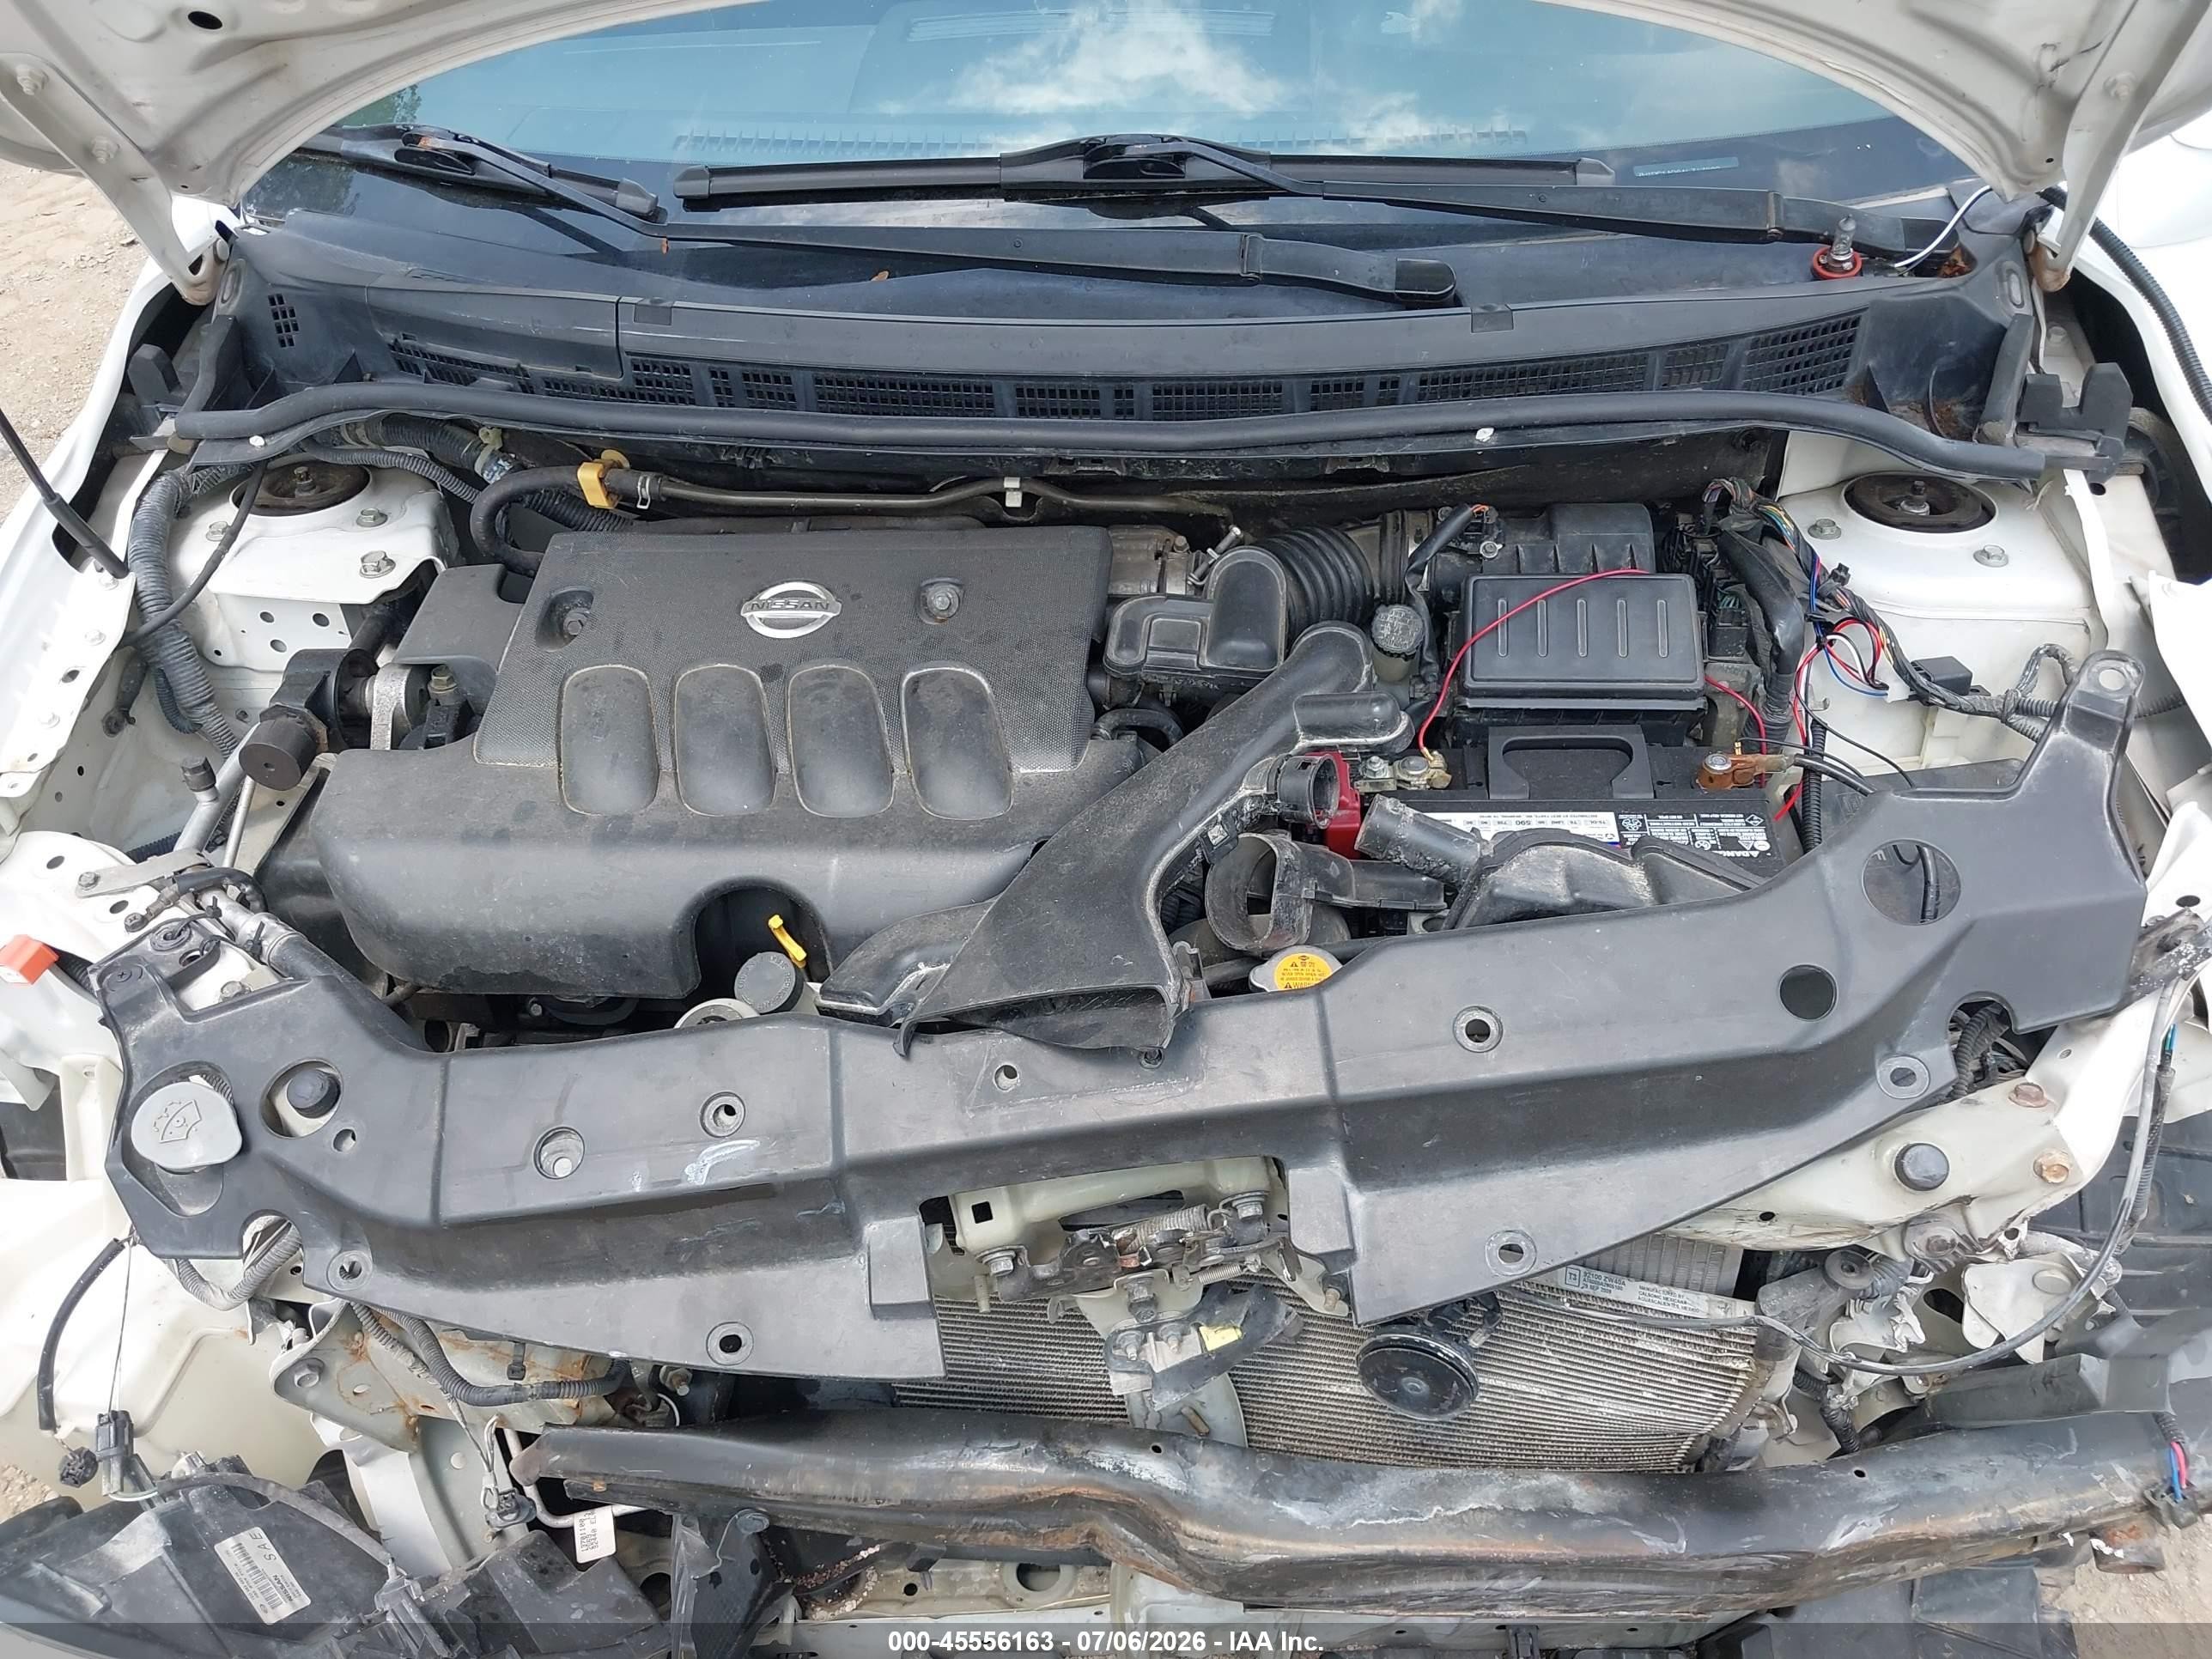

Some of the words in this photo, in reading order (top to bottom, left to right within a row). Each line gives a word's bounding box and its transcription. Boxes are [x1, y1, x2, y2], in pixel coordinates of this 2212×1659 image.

[750, 599, 830, 611] NISSAN
[1568, 1272, 1577, 1281] T3
[272, 1574, 294, 1601] NISSAN
